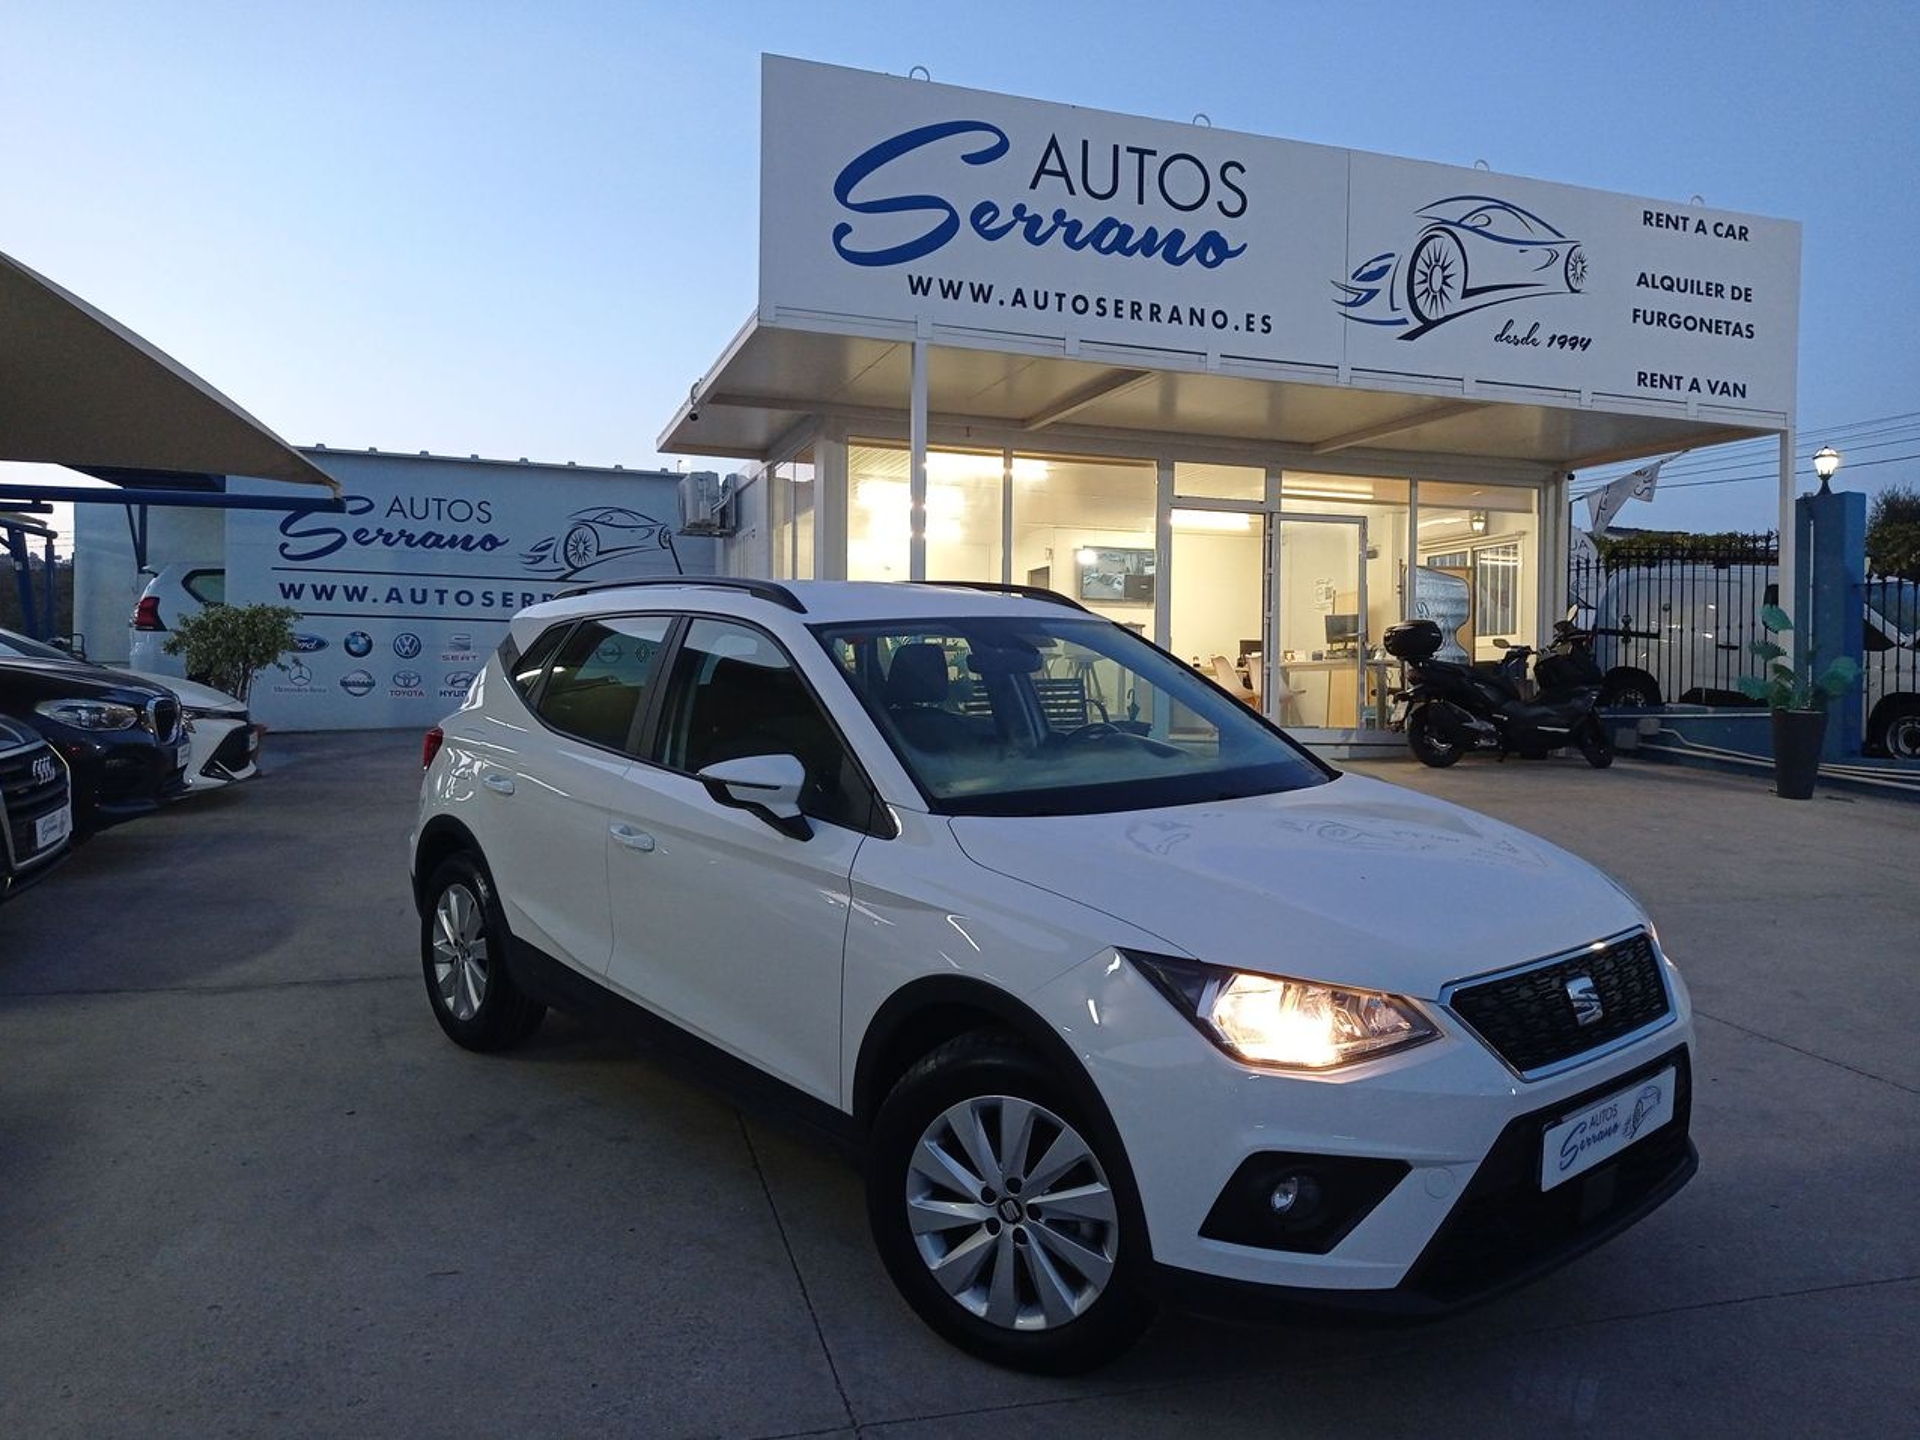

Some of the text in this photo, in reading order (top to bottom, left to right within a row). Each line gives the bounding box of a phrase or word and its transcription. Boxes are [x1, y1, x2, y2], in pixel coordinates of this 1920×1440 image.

[1029, 132, 1248, 219] AUTOS
[832, 120, 1248, 269] Serrano
[1642, 210, 1749, 242] RENT A CAR
[1636, 271, 1753, 303] ALQUILER DE
[907, 274, 1272, 335] WWW.AUTOSERRANO.ES
[1493, 318, 1593, 352] desde 1994
[1632, 307, 1755, 340] FURGONETAS
[1636, 371, 1747, 399] RENT A VAN
[384, 494, 492, 525] AUTOS
[278, 496, 510, 562] Serrano
[278, 582, 554, 609] WWW.AUTOSERR
[389, 689, 425, 698] TOYOTA
[1589, 1104, 1618, 1130] AUTOS
[1560, 1121, 1621, 1172] Serrano
